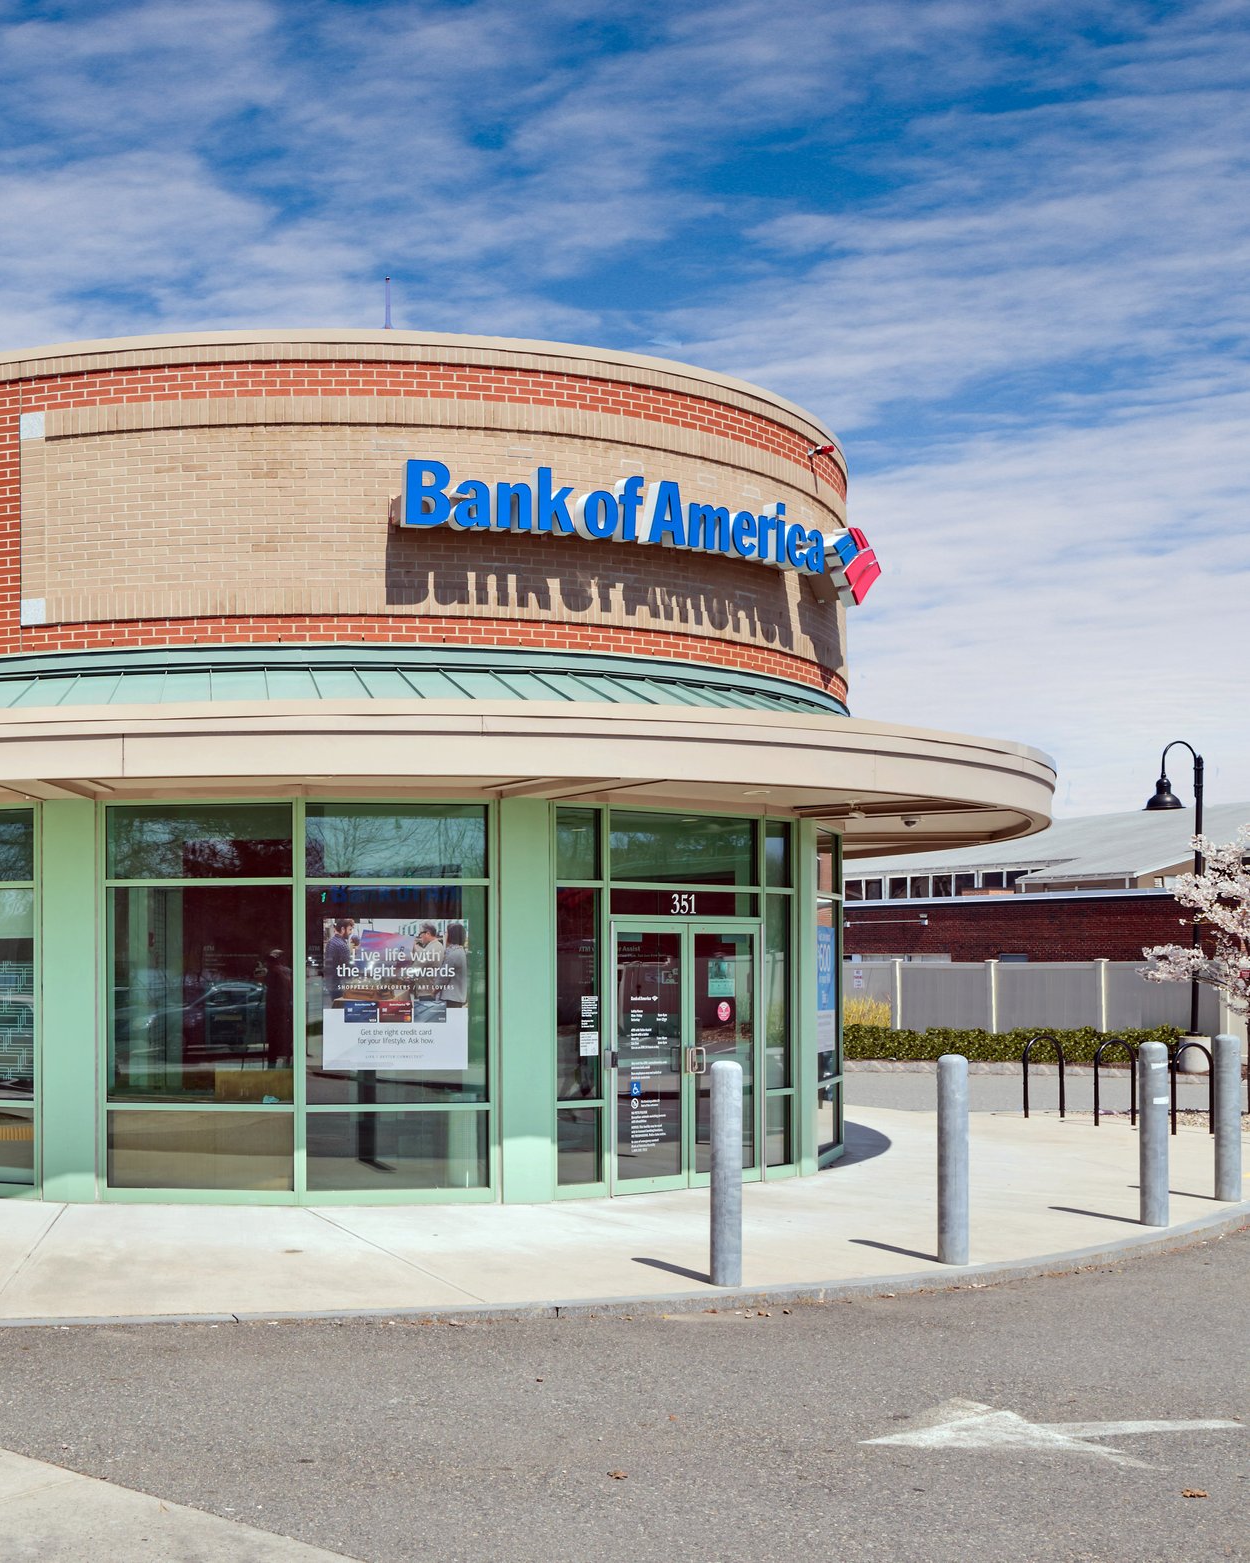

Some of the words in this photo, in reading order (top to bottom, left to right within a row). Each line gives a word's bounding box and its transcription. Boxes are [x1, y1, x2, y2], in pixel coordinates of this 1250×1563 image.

[400, 459, 574, 536] Bank
[575, 476, 644, 543] of
[637, 480, 825, 575] America
[670, 893, 697, 914] 351
[352, 949, 380, 962] Live
[385, 948, 406, 962] life
[409, 949, 441, 962] with
[336, 964, 359, 977] the
[364, 964, 397, 980] right
[400, 964, 456, 977] rewards
[385, 1029, 399, 1037] right
[367, 1038, 380, 1046] your
